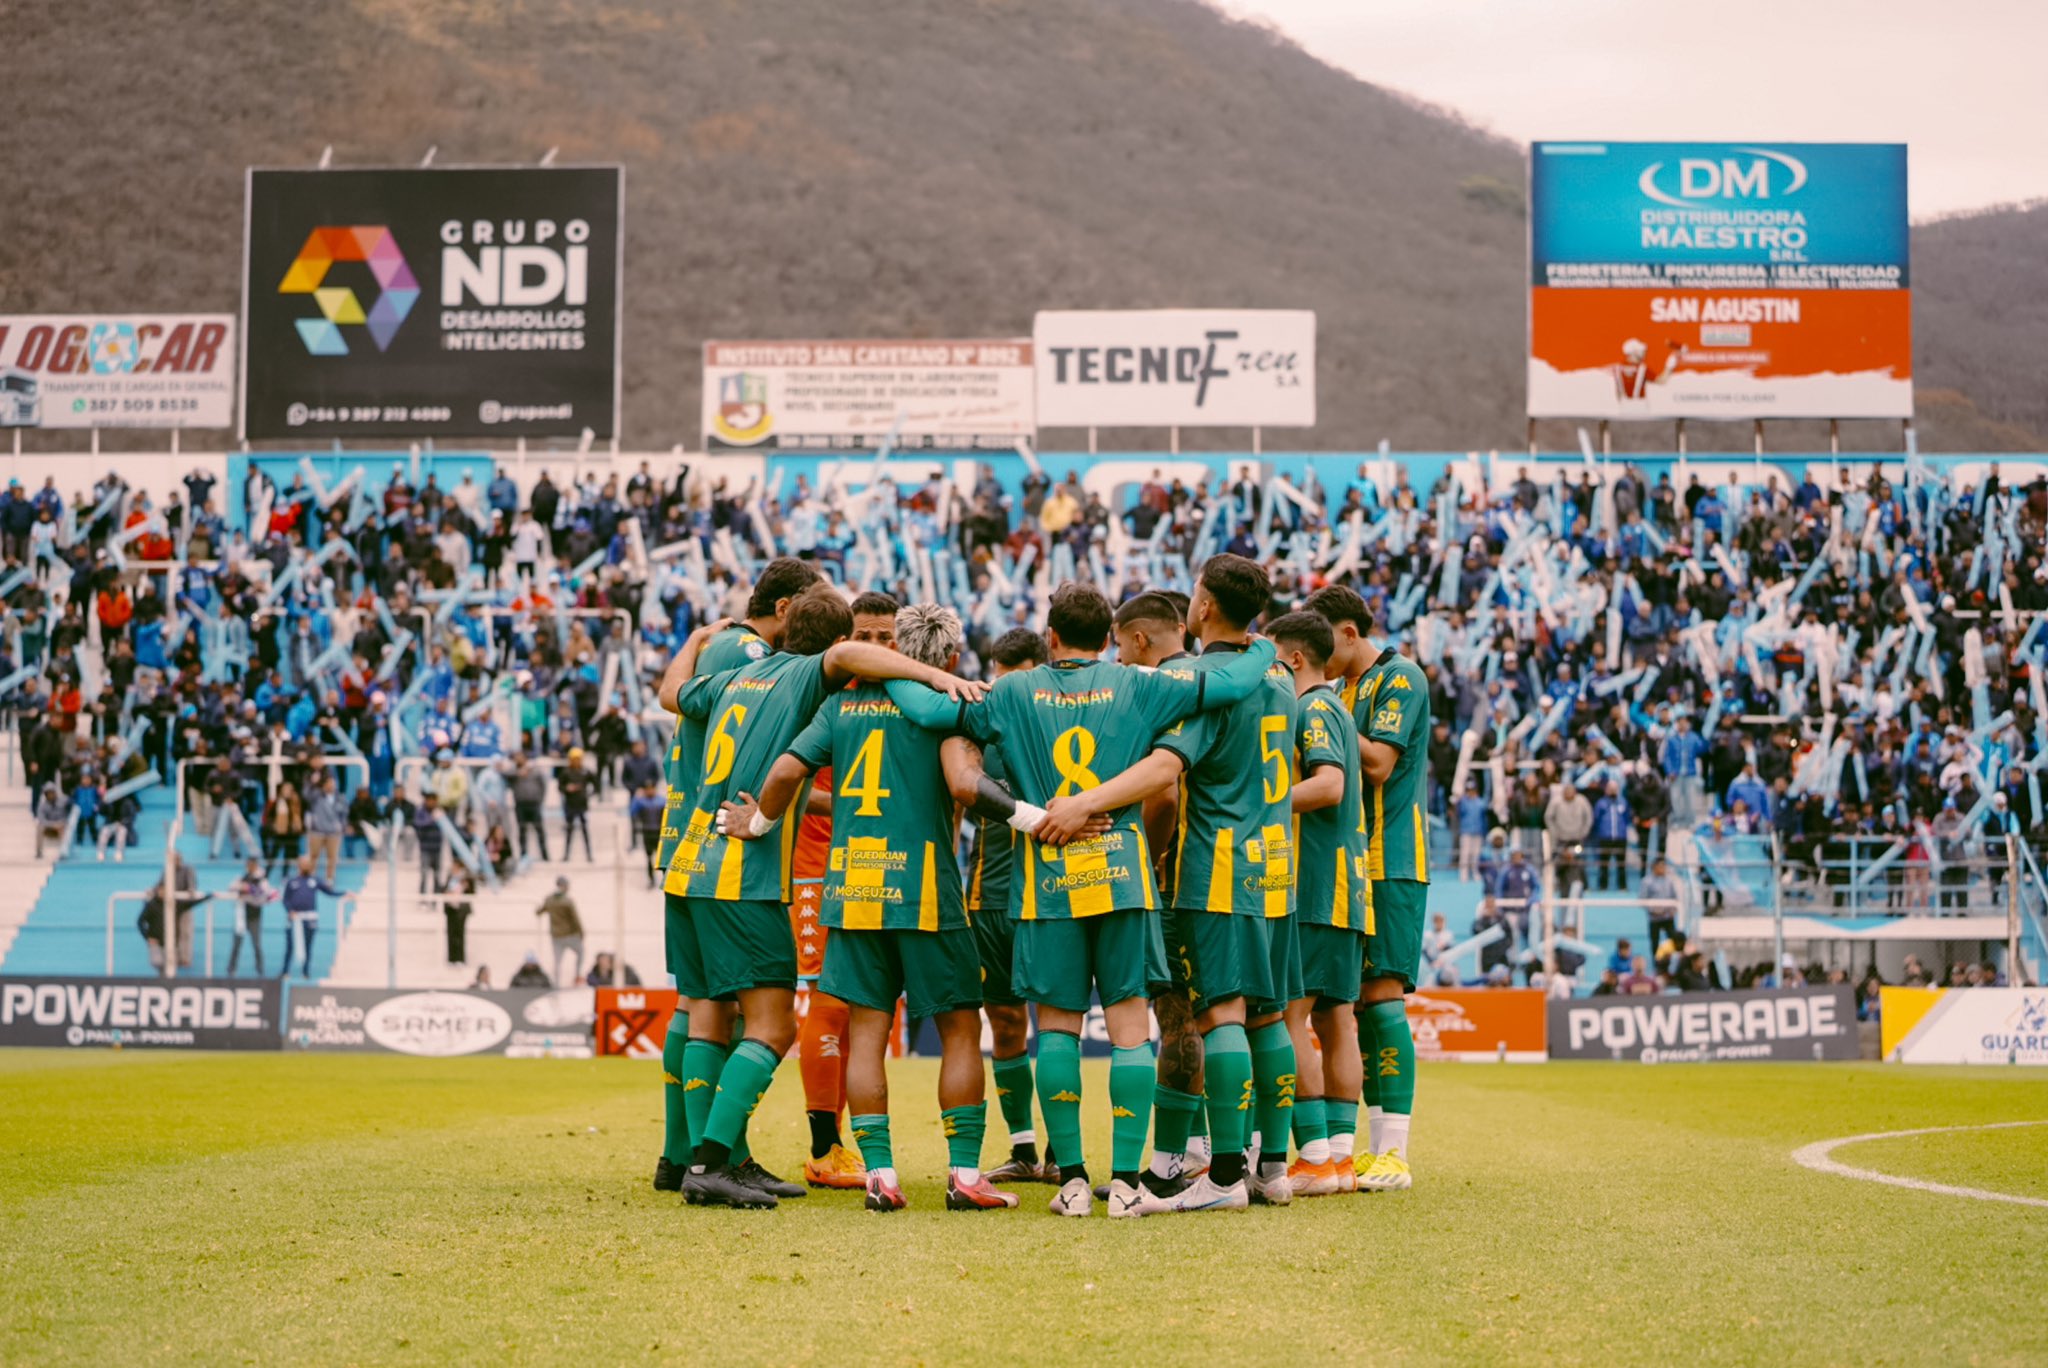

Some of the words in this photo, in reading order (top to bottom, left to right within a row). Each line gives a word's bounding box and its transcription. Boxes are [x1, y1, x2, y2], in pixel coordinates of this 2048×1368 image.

[1679, 158, 1770, 199] DM
[1641, 209, 1807, 227] DISTRIBUIDORA
[440, 219, 590, 244] GRUPO
[1641, 227, 1808, 249] MAESTRO
[1777, 265, 1901, 280] ELECTRICIDAD
[440, 310, 586, 330] DESARROLLOS
[1650, 297, 1699, 323] SAN
[1702, 297, 1800, 323] AGUSTIN
[441, 330, 586, 350] INTELIGENTES
[717, 346, 811, 366] INSTITUTO
[815, 346, 852, 366] SAN
[855, 346, 949, 366] CAYETANO
[839, 700, 904, 719] PLUSMA
[1034, 688, 1114, 711] PLUSMAR
[1375, 710, 1403, 729] SPI
[704, 703, 747, 786] 6
[1303, 728, 1329, 745] SPI
[1051, 725, 1102, 798] 8
[1259, 714, 1290, 804] 5
[839, 728, 890, 816] 4
[852, 850, 908, 862] GUEDIKIAN
[1055, 865, 1130, 888] MOSCUZZA
[835, 884, 903, 899] MOSCUZZA
[2, 983, 264, 1029] POWERADE
[382, 1016, 497, 1034] SAMER
[1568, 994, 1839, 1051] POWERADE
[141, 1031, 195, 1044] POWER
[1659, 1047, 1707, 1063] PAUS
[1716, 1044, 1773, 1059] POWER
